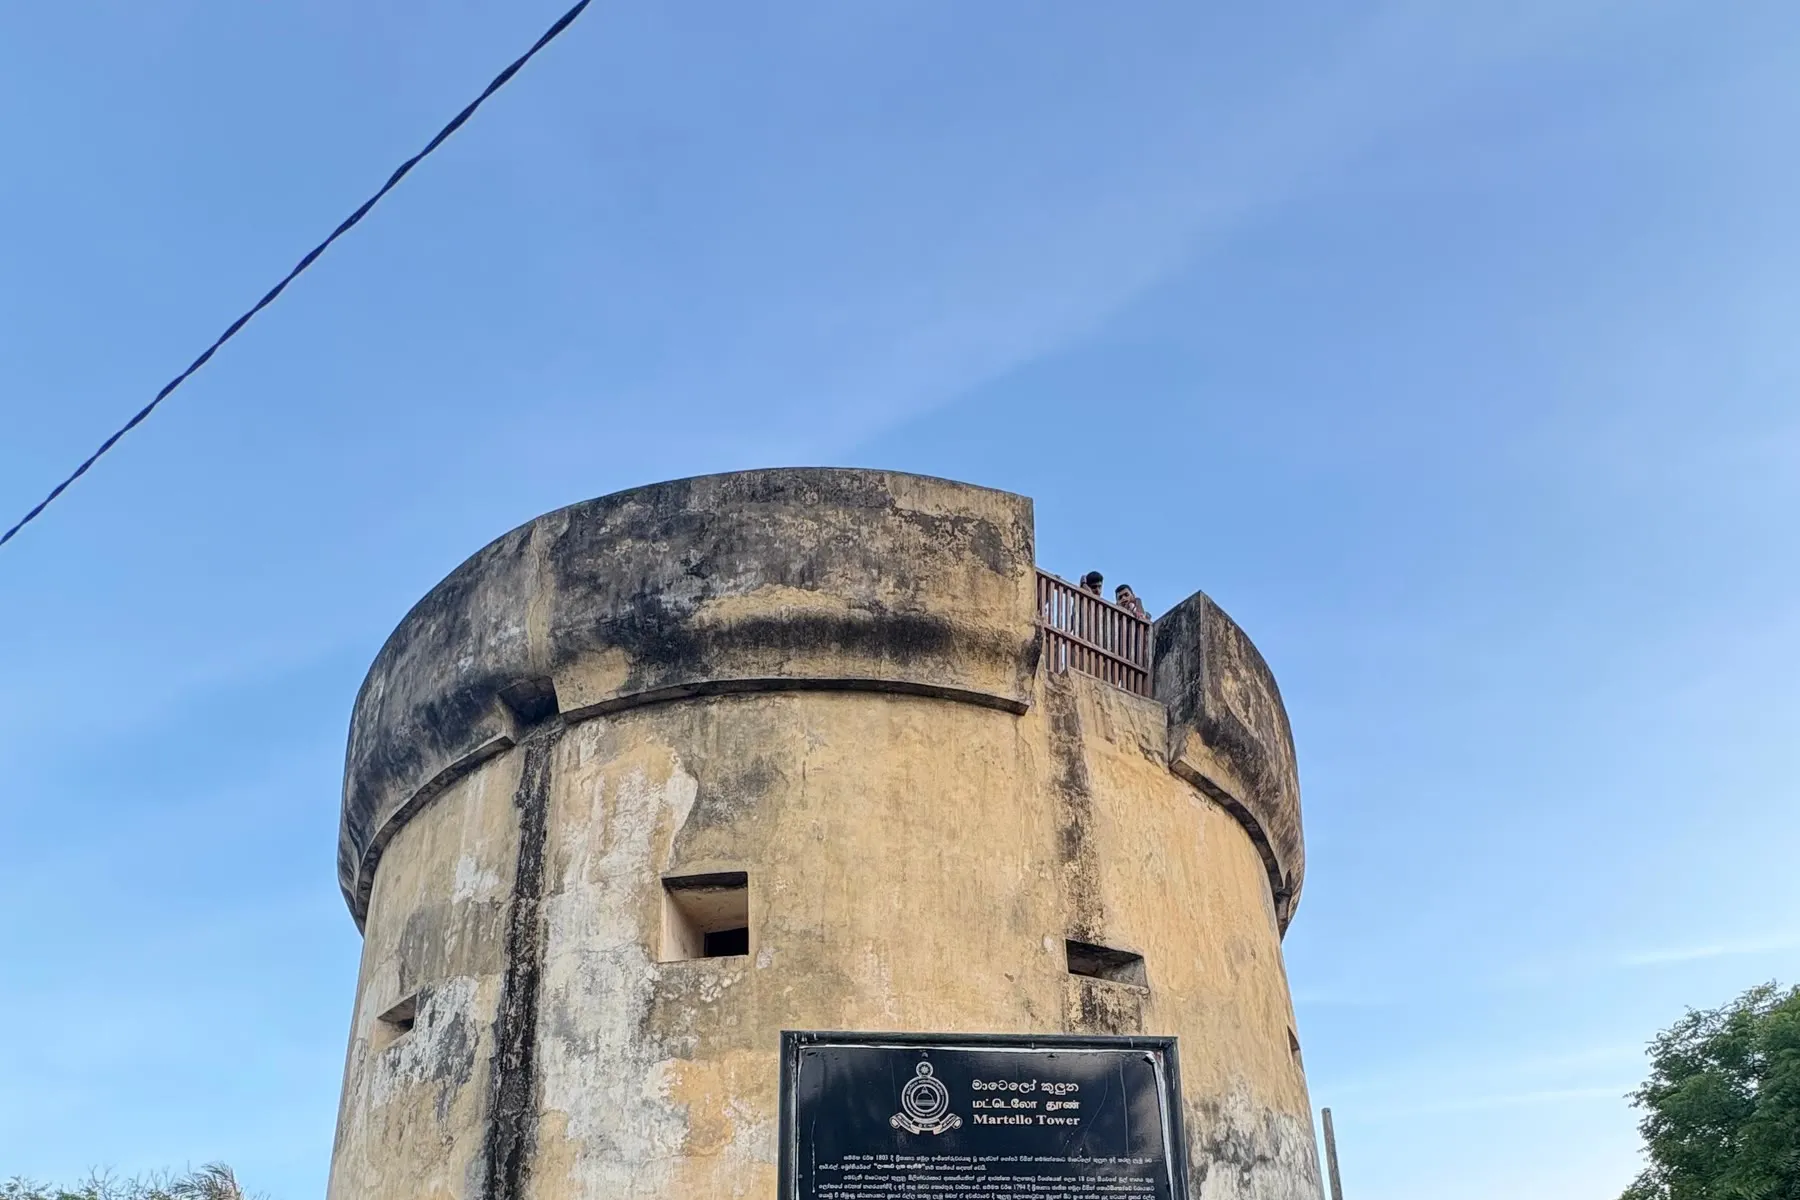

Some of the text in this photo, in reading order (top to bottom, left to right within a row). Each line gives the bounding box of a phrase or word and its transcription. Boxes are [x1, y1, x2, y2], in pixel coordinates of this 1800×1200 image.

[1045, 1099, 1080, 1112] தூண்
[972, 1114, 1033, 1125] Martello
[1036, 1114, 1081, 1126] Tower
